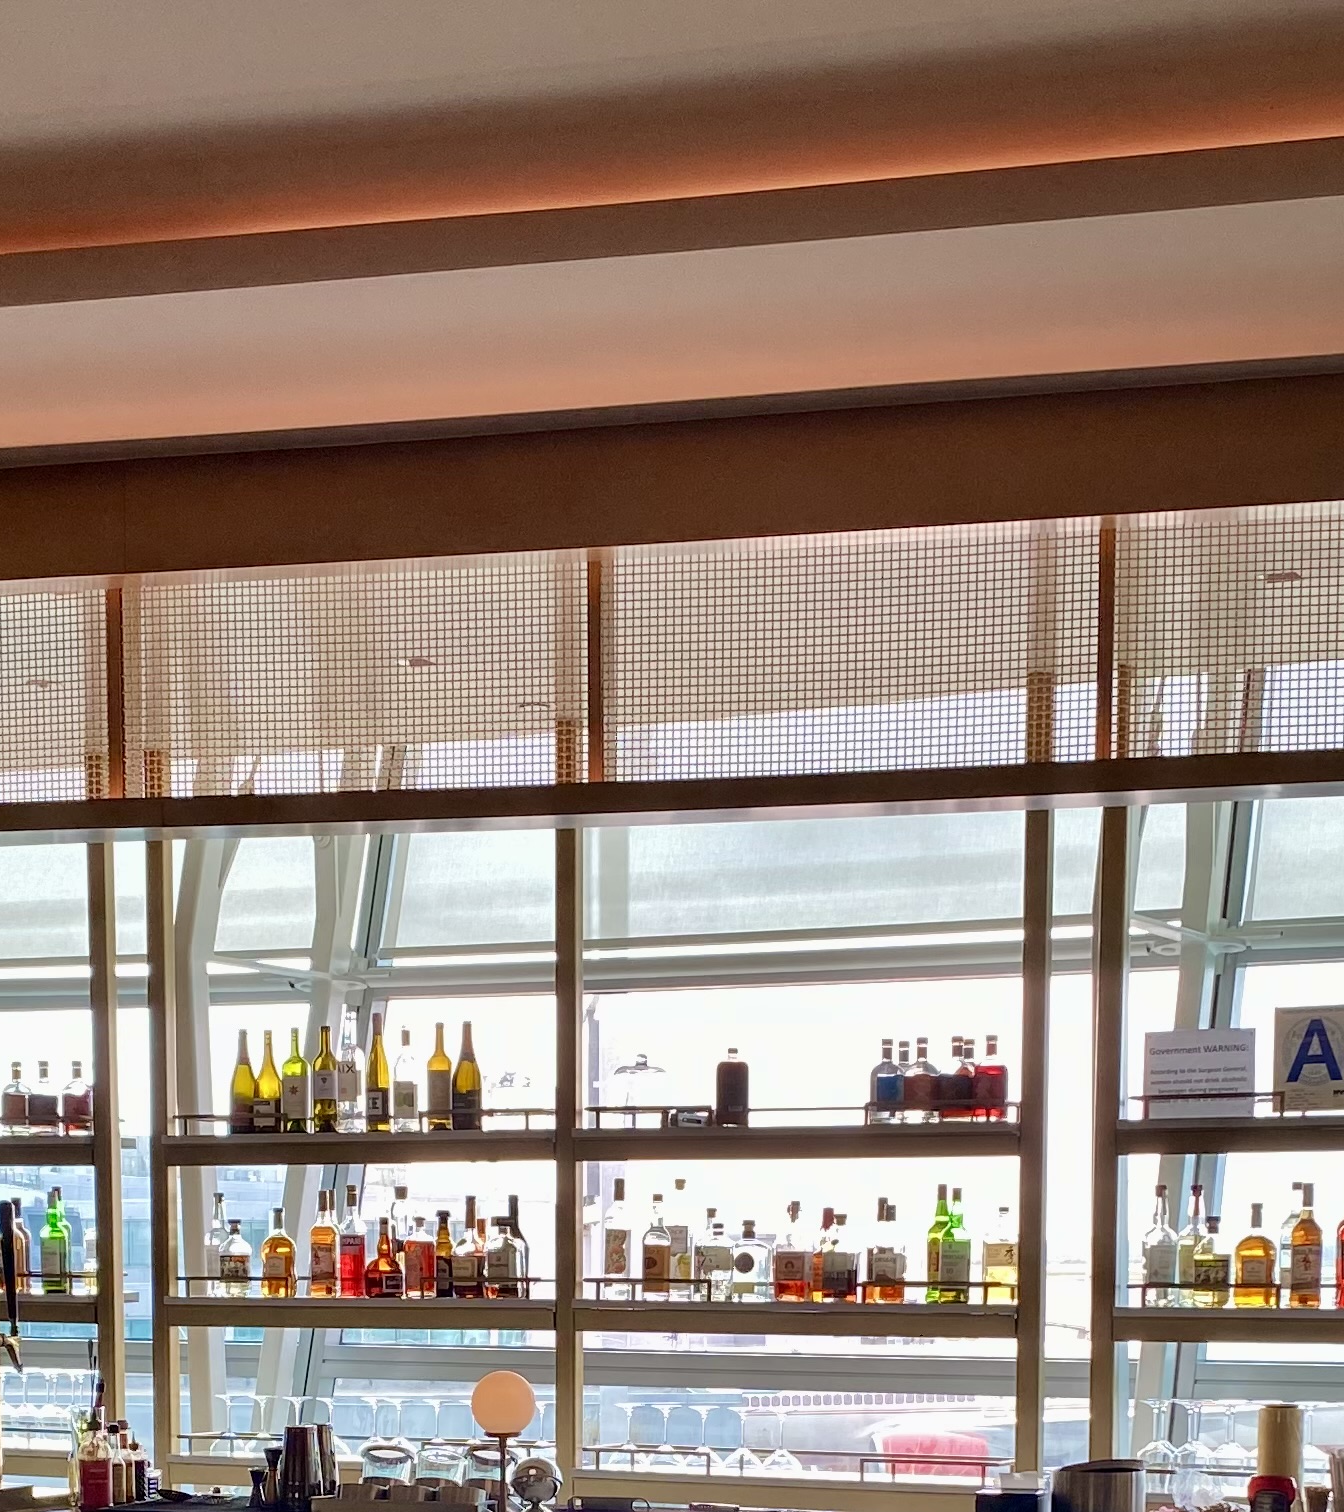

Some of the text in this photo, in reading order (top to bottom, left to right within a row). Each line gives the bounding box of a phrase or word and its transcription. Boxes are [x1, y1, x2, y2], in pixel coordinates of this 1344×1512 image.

[1149, 1043, 1249, 1056] Government WARNING:
[1286, 1019, 1343, 1083] A
